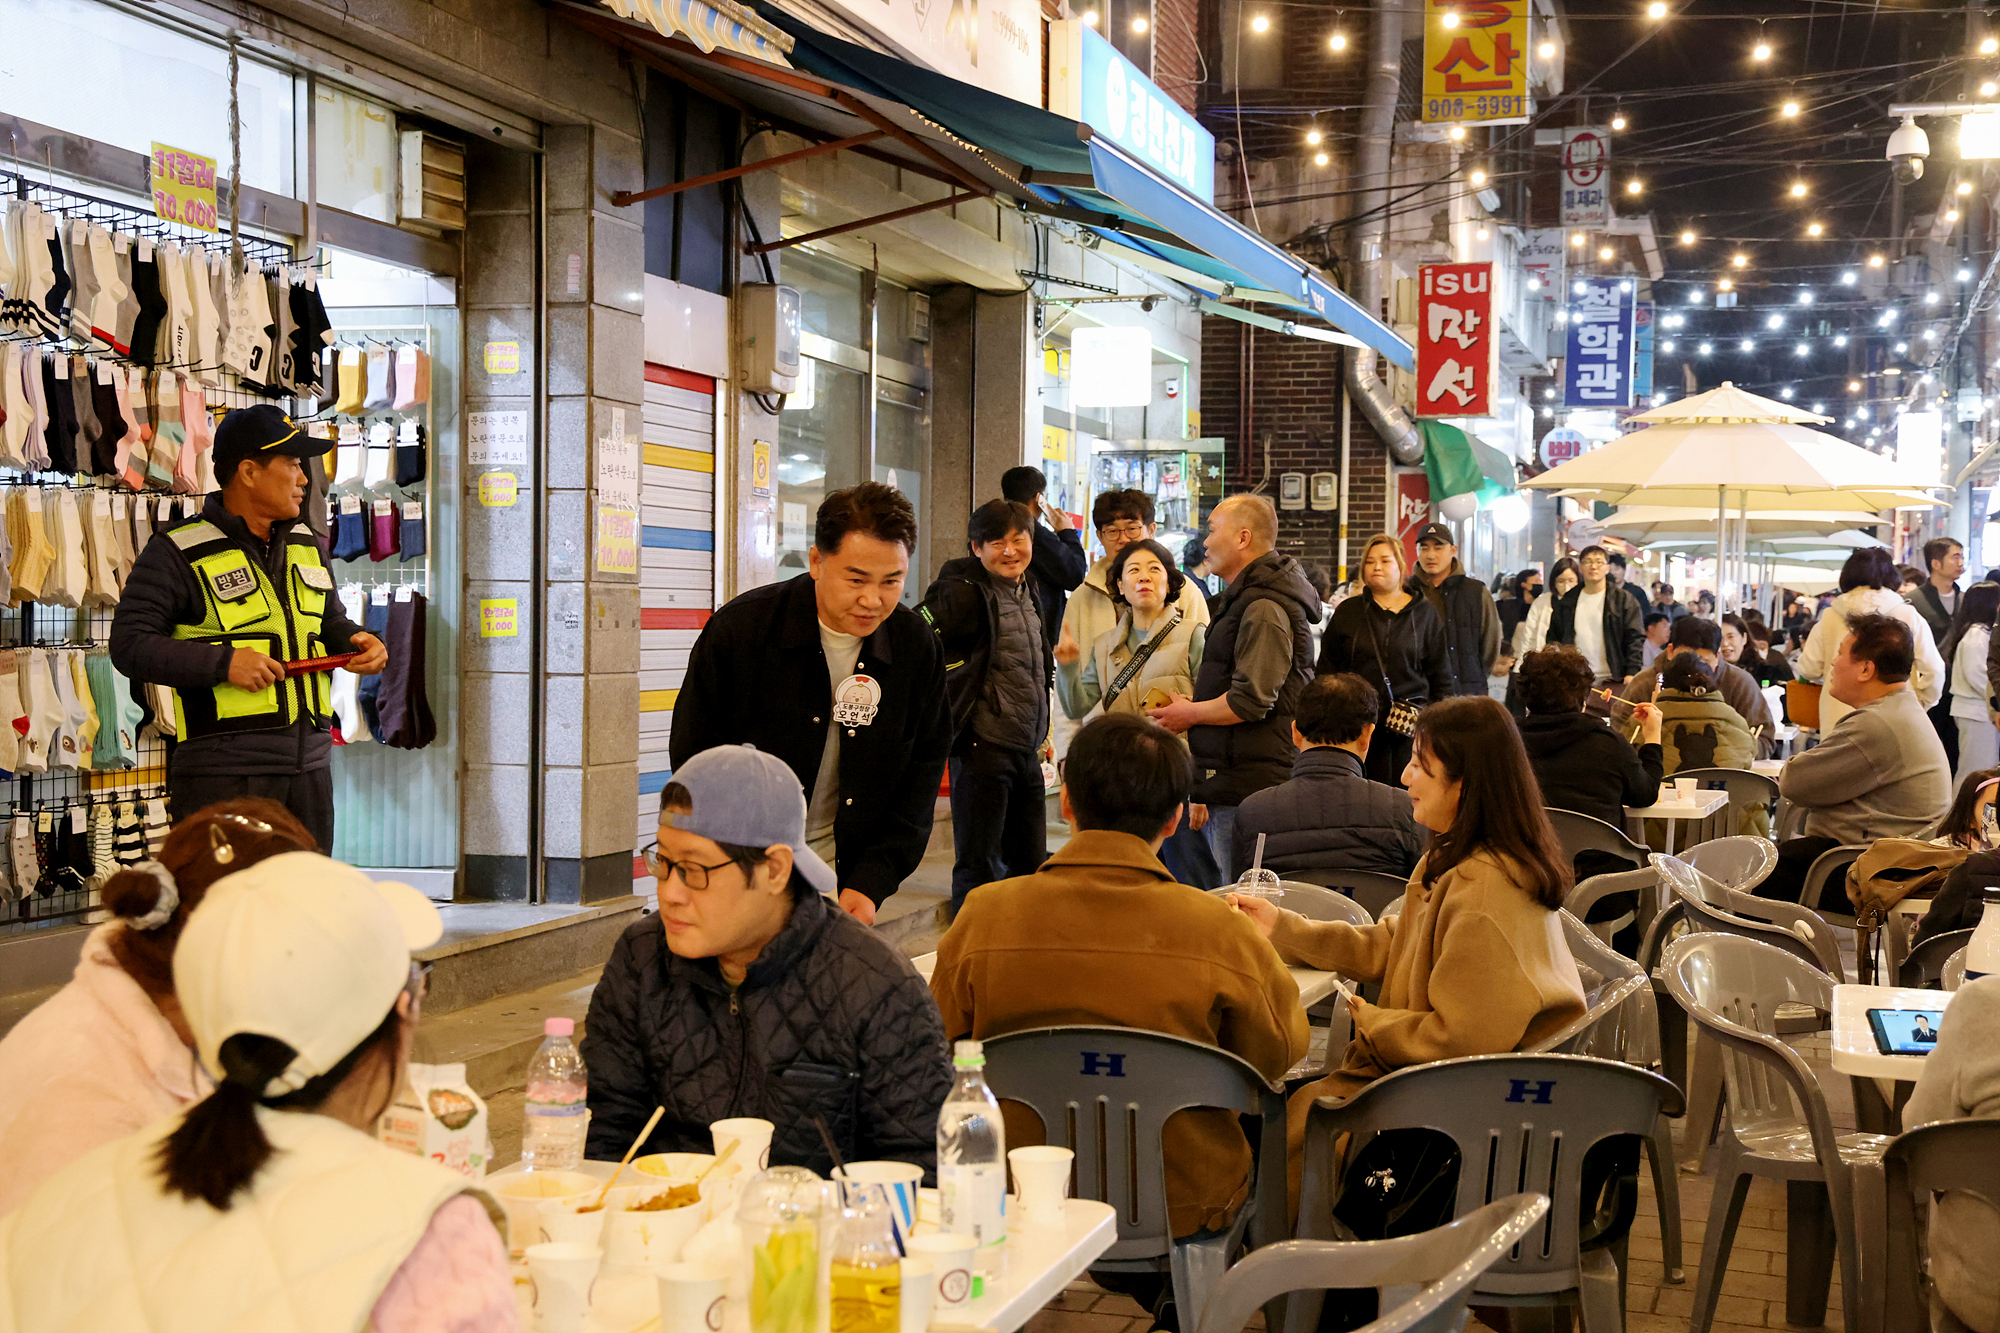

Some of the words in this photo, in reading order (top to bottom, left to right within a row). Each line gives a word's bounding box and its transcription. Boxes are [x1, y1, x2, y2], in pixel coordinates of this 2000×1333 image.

[1428, 95, 1522, 118] 908-9991
[154, 150, 215, 191] 11켤레
[155, 191, 217, 229] 10,000
[1424, 268, 1487, 296] isu
[486, 344, 518, 356] 한켤레
[1576, 285, 1623, 400] 철학관
[488, 360, 516, 370] 1,000
[470, 451, 487, 462] 문의
[481, 476, 513, 488] 한켤레
[484, 492, 512, 502] 1,000
[602, 514, 635, 539] 11켤레
[600, 545, 635, 569] 10,000
[217, 570, 248, 589] 방범
[483, 607, 514, 618] 한켤레
[486, 621, 512, 631] 1,000
[1080, 1052, 1126, 1077] H
[1505, 1079, 1557, 1104] H
